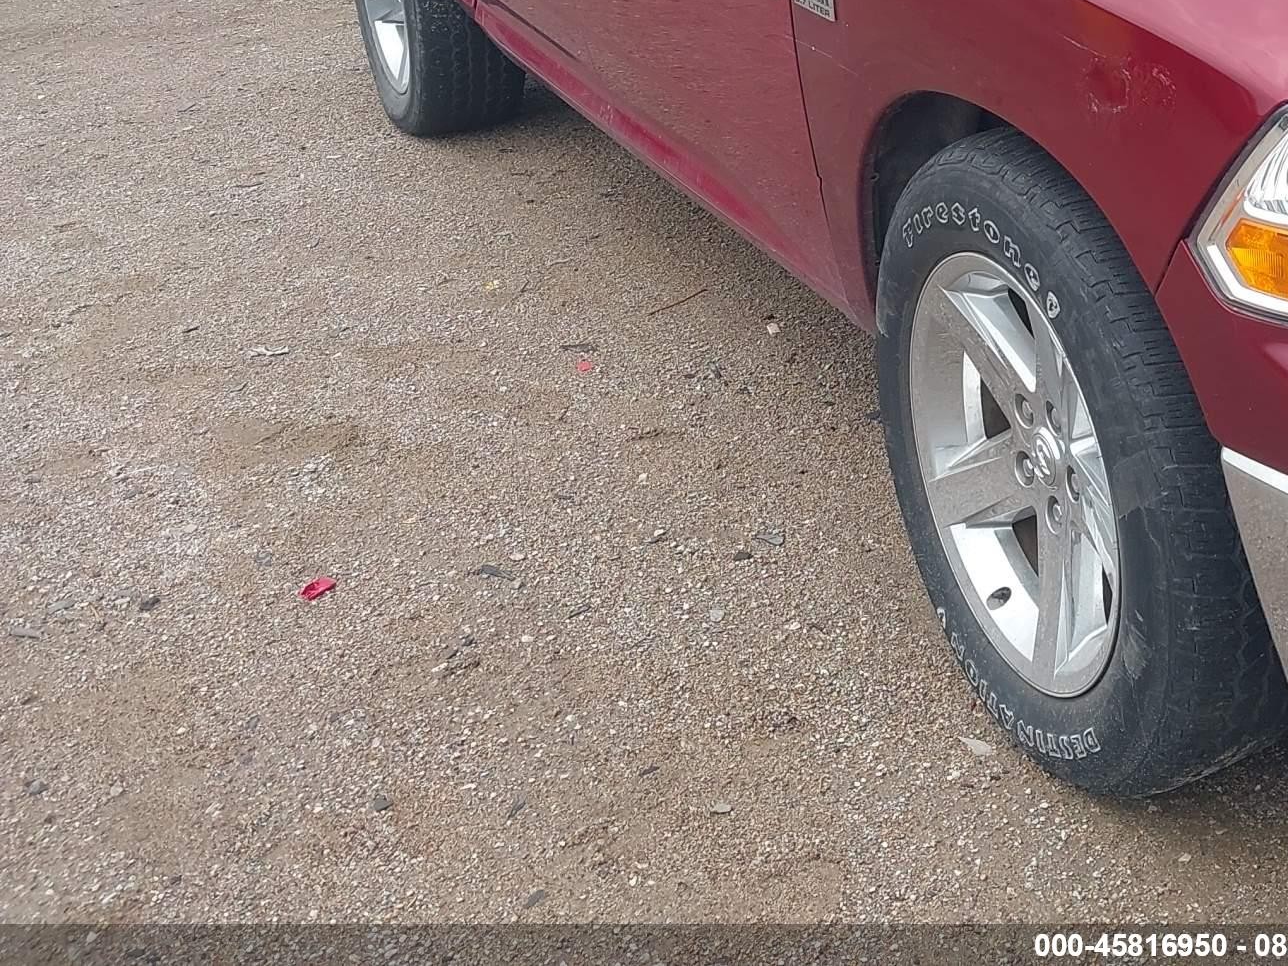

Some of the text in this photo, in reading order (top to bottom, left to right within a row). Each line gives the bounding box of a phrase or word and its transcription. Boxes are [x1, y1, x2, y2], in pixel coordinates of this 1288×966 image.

[808, 0, 831, 18] LITER
[902, 201, 1041, 292] Firestone
[951, 632, 1101, 760] DESTINATION
